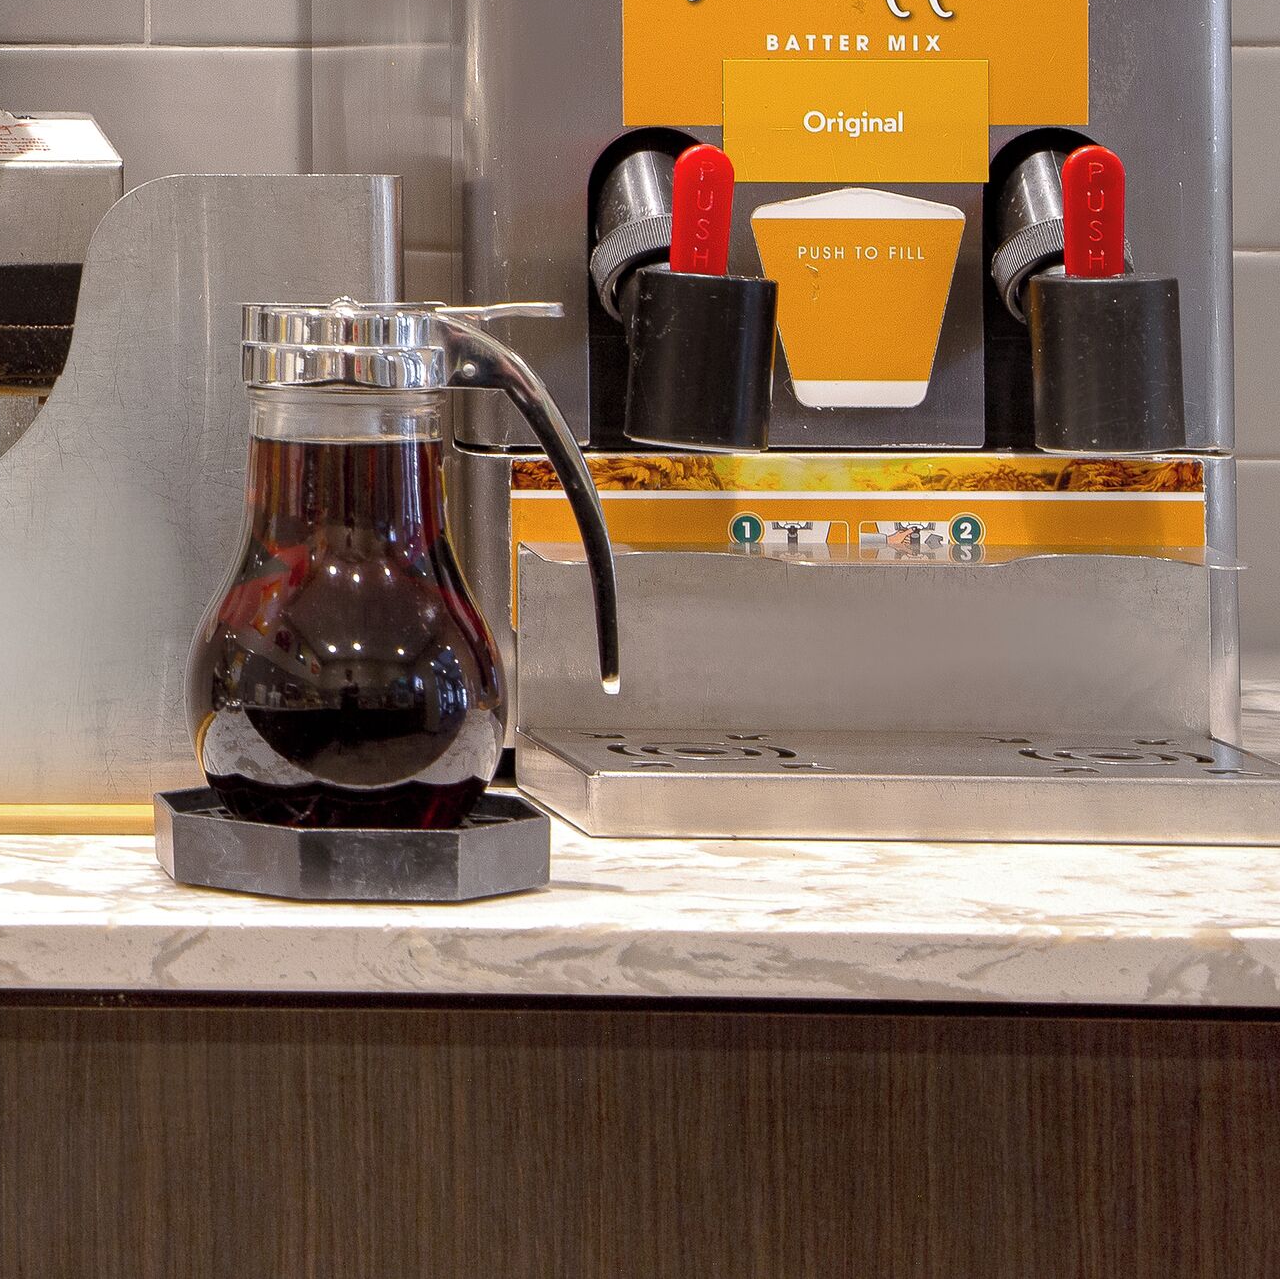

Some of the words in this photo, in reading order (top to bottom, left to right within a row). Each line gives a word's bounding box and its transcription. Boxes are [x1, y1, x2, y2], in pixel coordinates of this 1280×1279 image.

[766, 34, 869, 52] BATTER
[887, 34, 941, 52] MIX
[803, 110, 904, 138] Original
[693, 161, 715, 268] PUSH
[1087, 162, 1104, 270] PUSH
[798, 246, 845, 260] PUSH
[855, 246, 878, 260] TO
[889, 246, 925, 260] FILL
[741, 521, 751, 538] 1
[959, 521, 973, 539] 2
